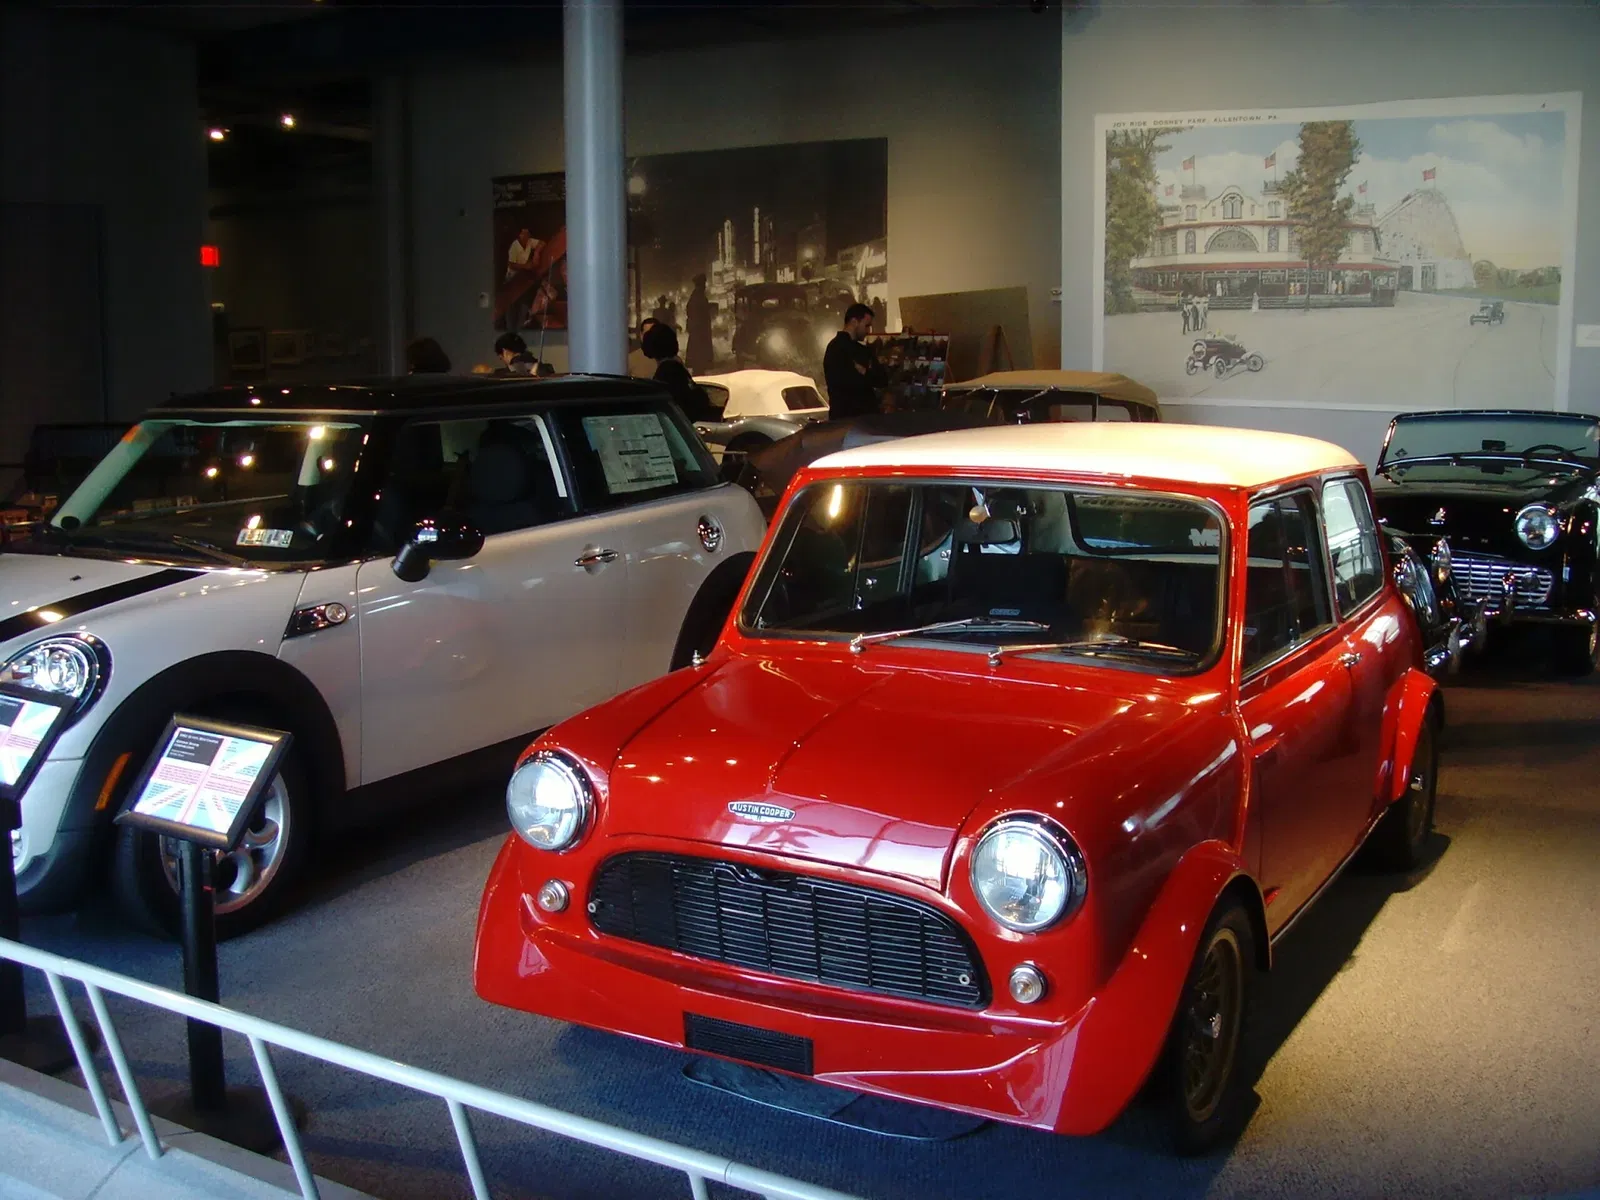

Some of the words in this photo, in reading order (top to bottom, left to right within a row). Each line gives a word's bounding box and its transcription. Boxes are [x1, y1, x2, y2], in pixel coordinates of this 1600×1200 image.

[1112, 121, 1126, 129] JOY
[731, 803, 759, 814] AUSTIN
[760, 808, 791, 819] COOPER
